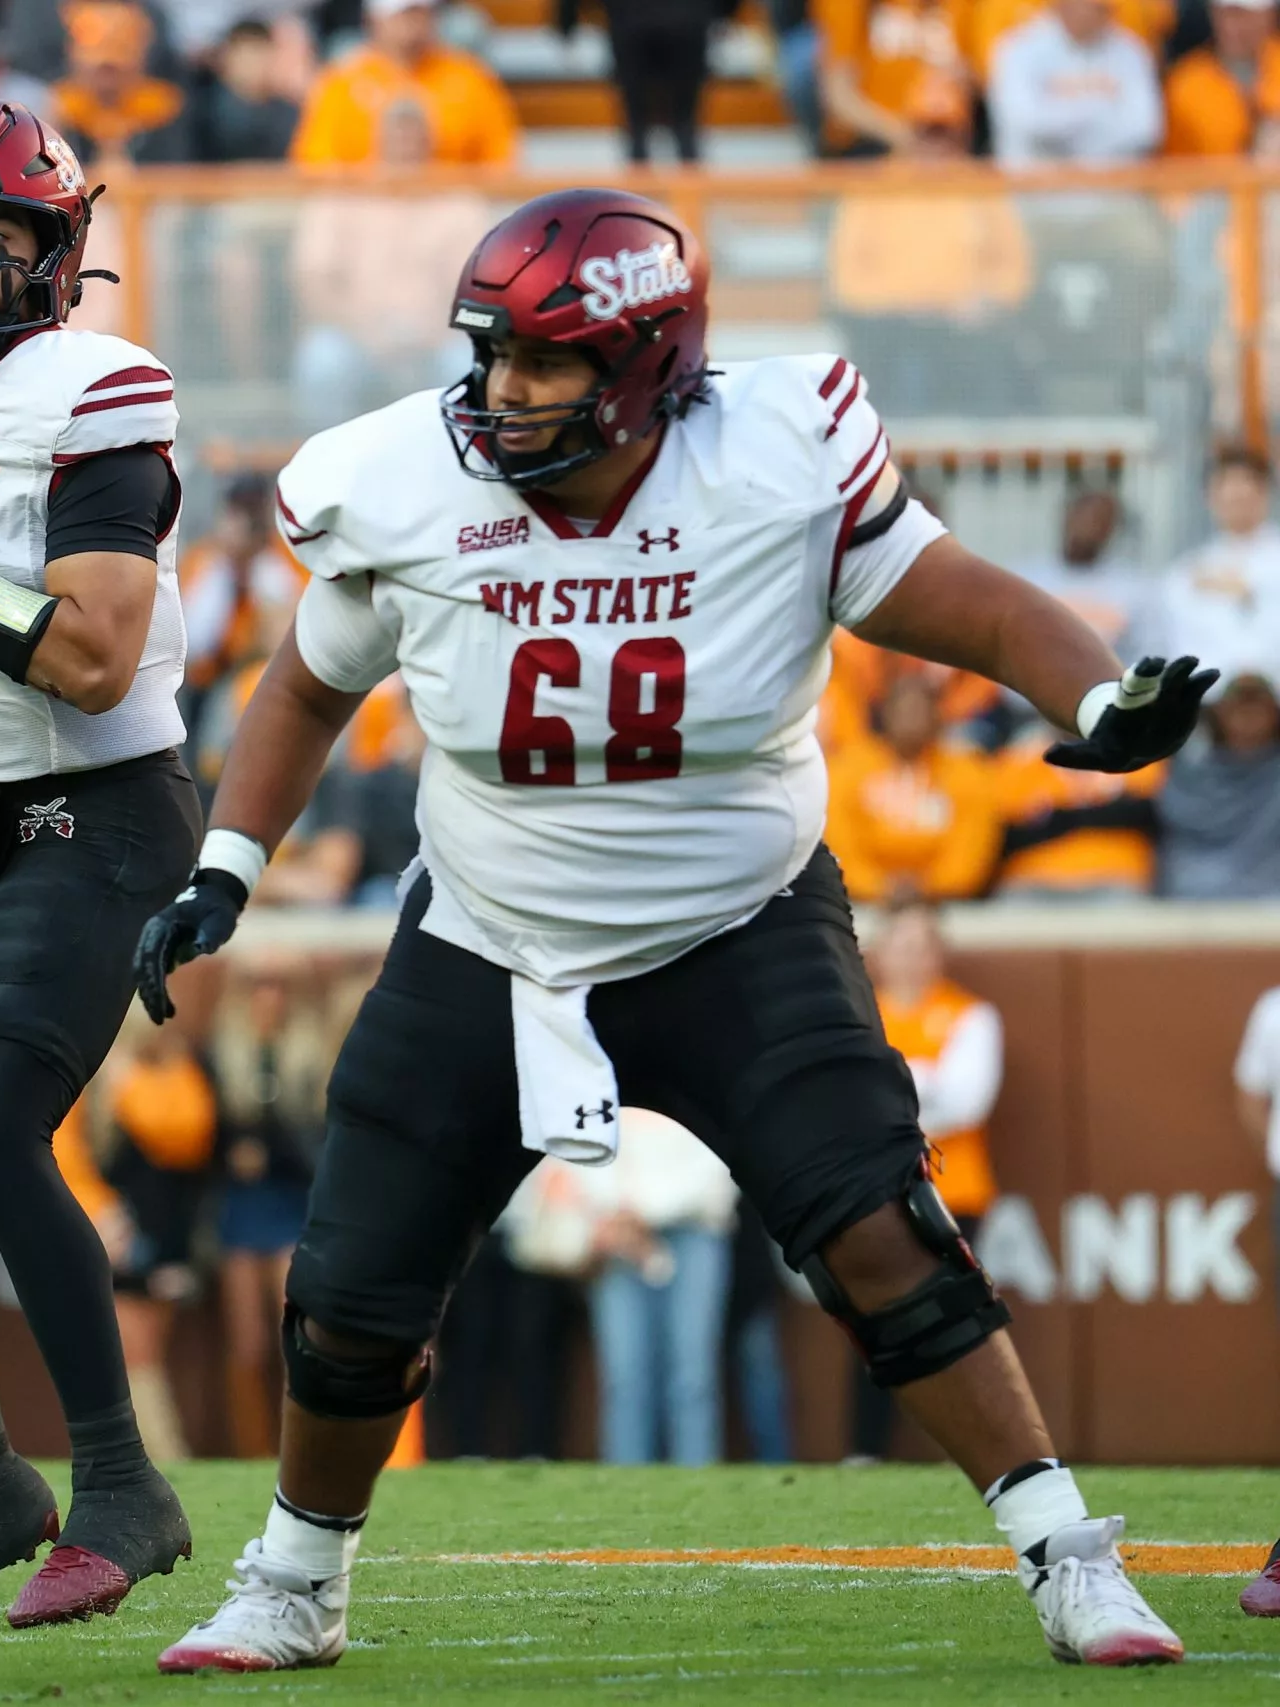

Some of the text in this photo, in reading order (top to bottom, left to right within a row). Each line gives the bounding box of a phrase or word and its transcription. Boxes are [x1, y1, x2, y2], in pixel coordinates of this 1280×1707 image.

[580, 242, 692, 321] State
[551, 570, 696, 625] STATE
[498, 636, 686, 786] 68
